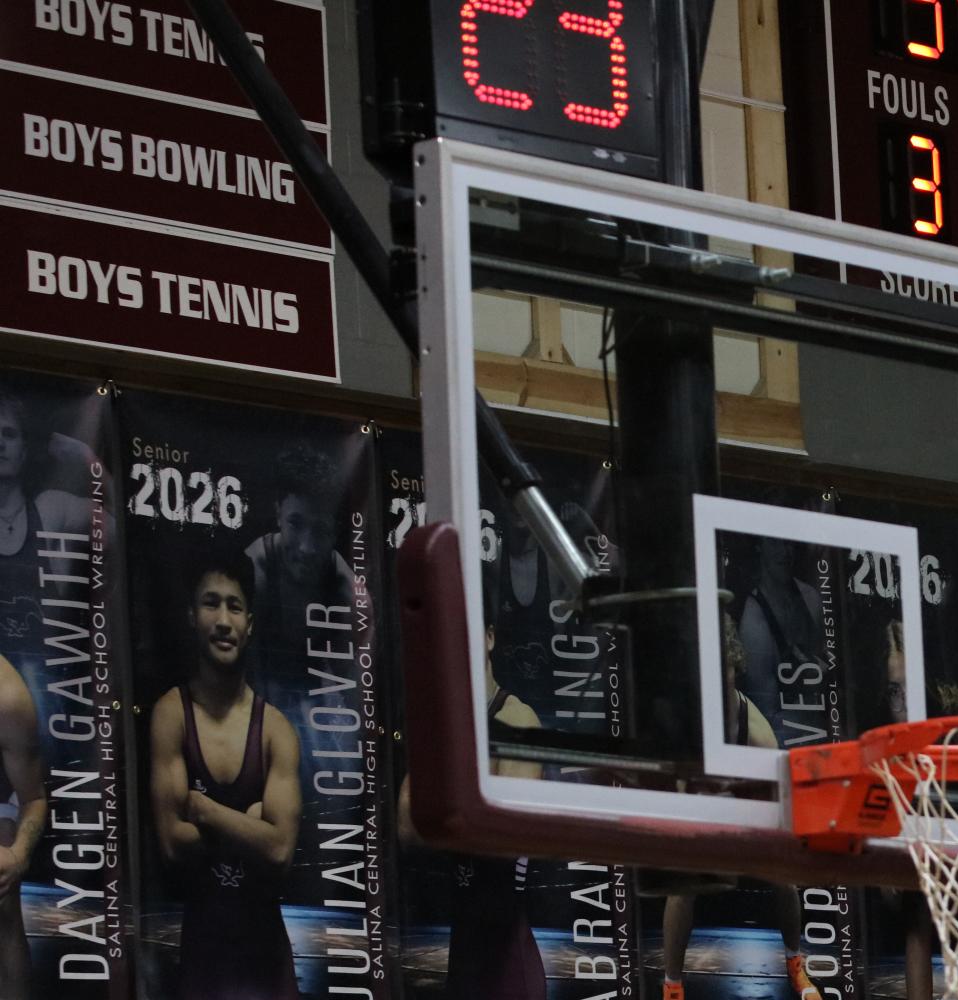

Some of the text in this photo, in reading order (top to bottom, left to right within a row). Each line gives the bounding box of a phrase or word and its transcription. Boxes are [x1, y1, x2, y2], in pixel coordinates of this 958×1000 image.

[35, 0, 266, 67] BOYS TEN
[460, 0, 629, 129] 23
[867, 69, 951, 127] FOULS
[23, 113, 296, 206] BOYS BOWLING
[910, 133, 944, 236] 3
[26, 248, 300, 335] BOYS TENNIS
[132, 437, 191, 466] Senior
[390, 468, 424, 492] Seni
[128, 461, 249, 532] 2026
[387, 497, 502, 563] 26
[817, 558, 837, 671] WRESTLING
[847, 549, 946, 606] 206
[89, 461, 123, 959] SALINA CENTRAL HIGH SCHOOL WRESTLING
[305, 601, 366, 796] GLOVER
[608, 663, 620, 738] CHOOL
[828, 680, 841, 744] HOOL
[36, 530, 110, 981] DAYGEN GAWITH
[351, 511, 385, 981] SALINA CENTRAL HIGH SCHOOL WRESTLING
[617, 922, 632, 997] SALINA
[841, 924, 855, 993] SALINA
